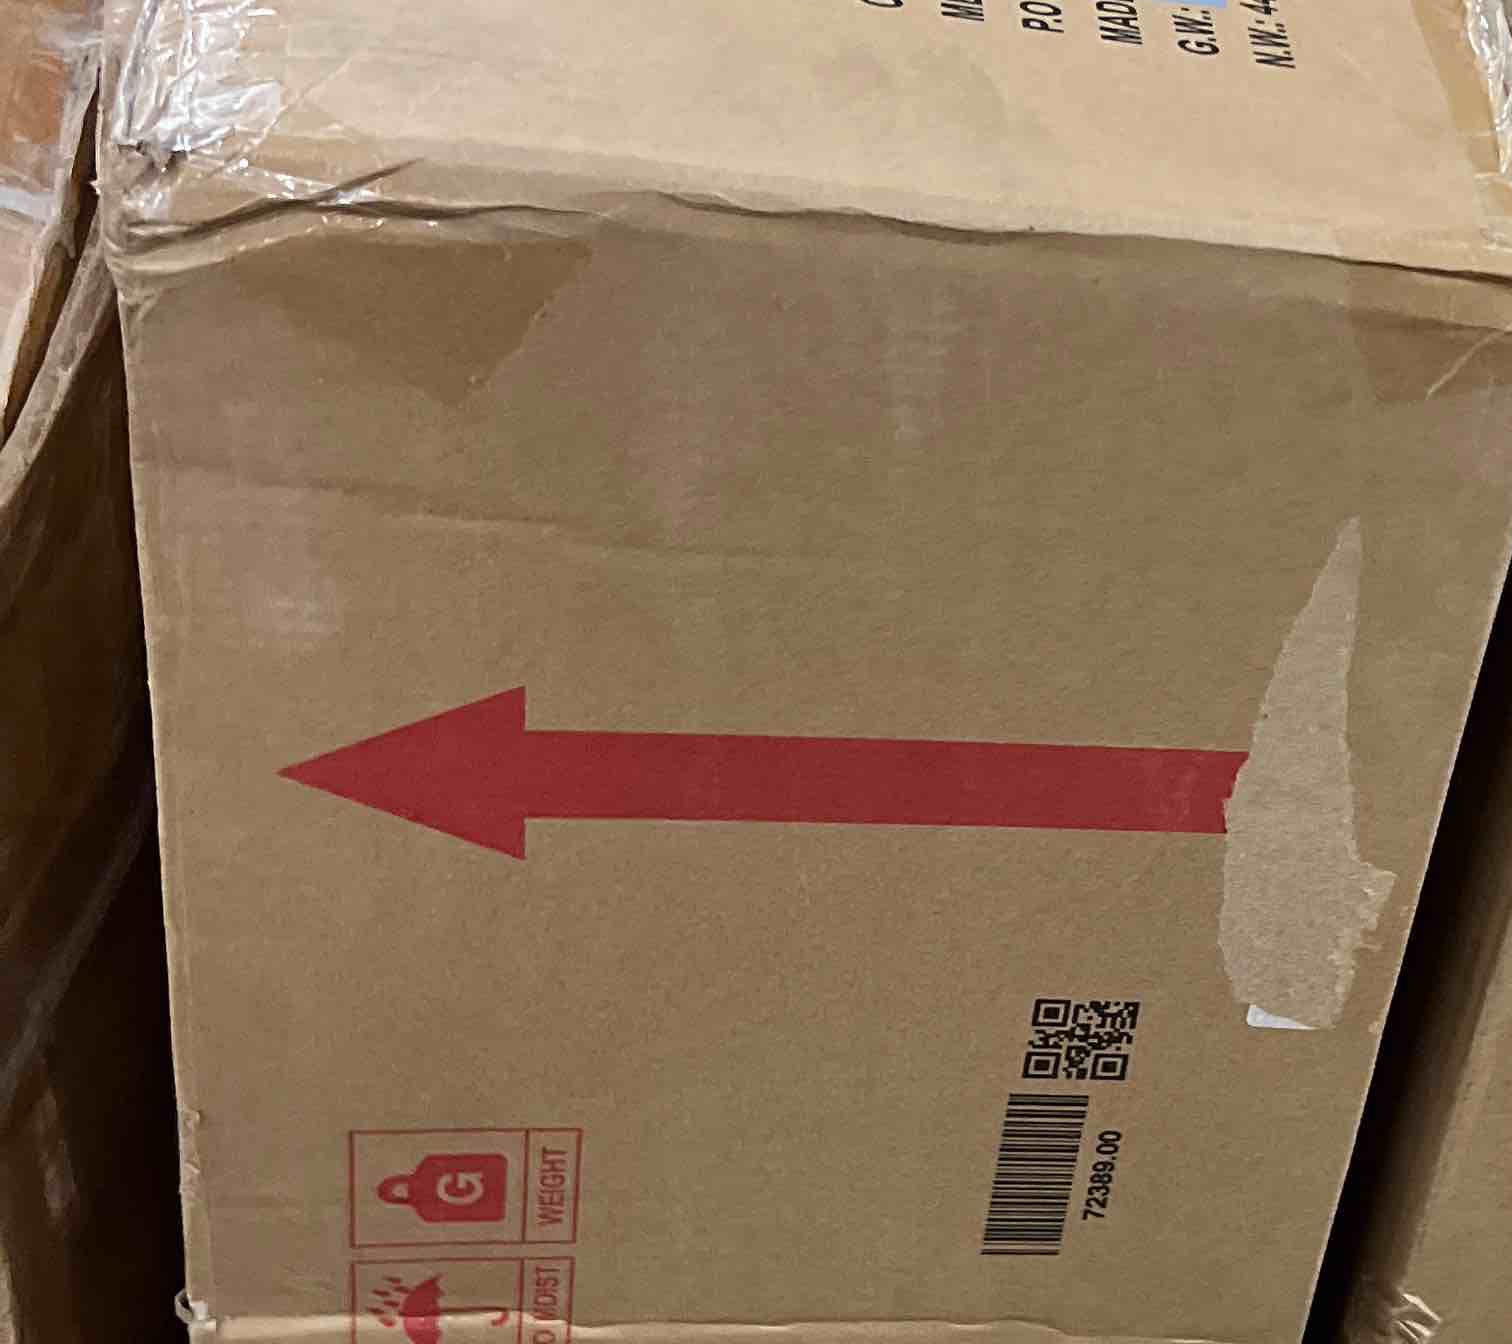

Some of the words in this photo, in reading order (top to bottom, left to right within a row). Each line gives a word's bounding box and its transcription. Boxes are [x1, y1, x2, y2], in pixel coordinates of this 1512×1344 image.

[1246, 19, 1297, 71] N.W.:
[535, 1145, 570, 1227] WEIGHT
[1081, 1129, 1123, 1221] 72389.00
